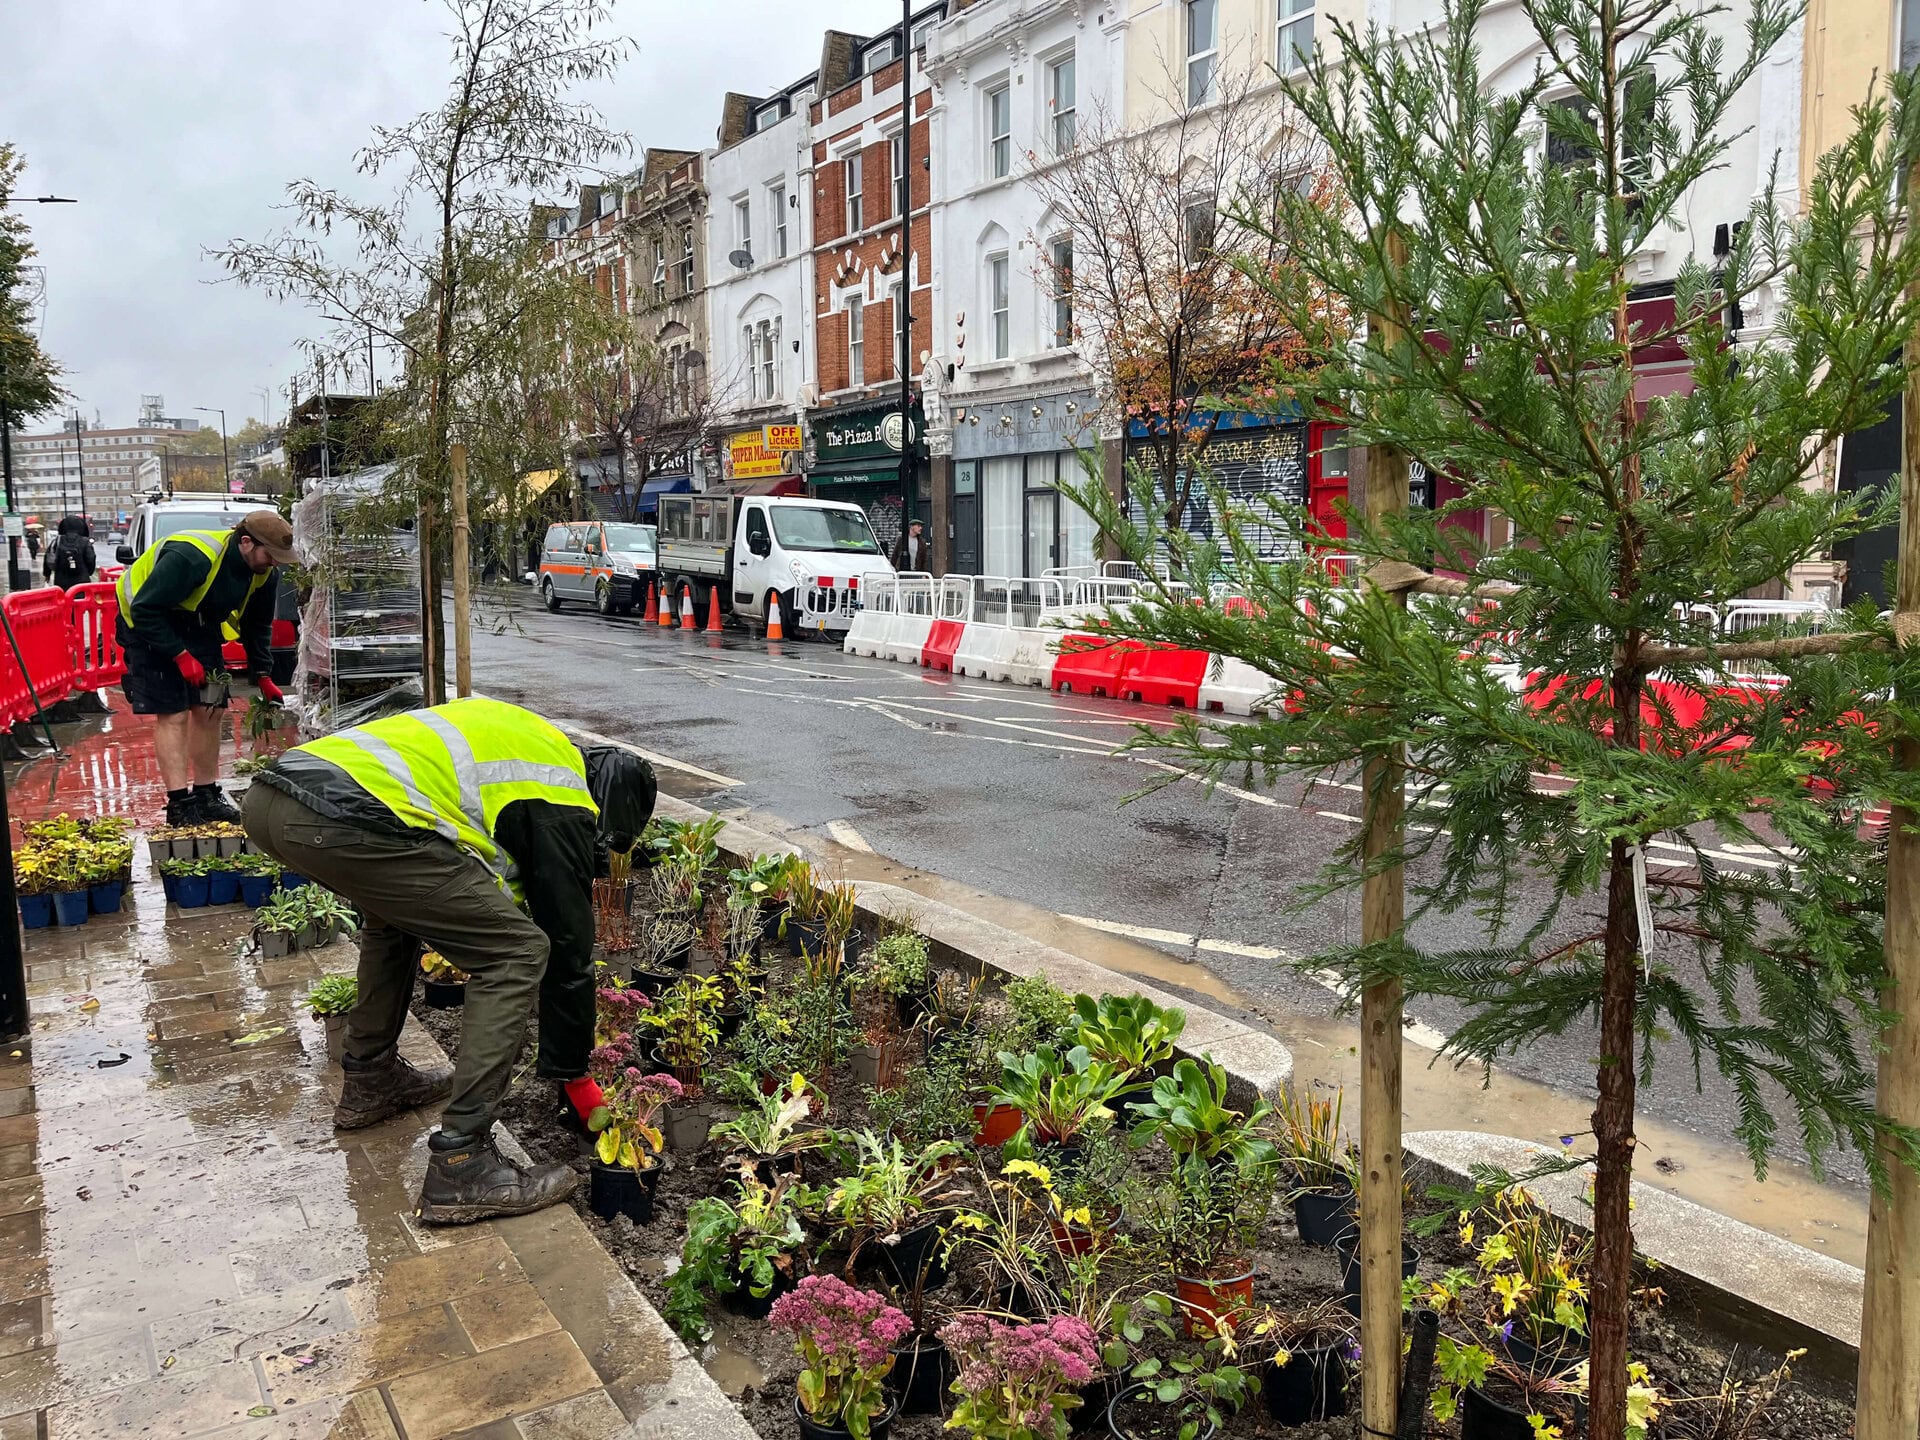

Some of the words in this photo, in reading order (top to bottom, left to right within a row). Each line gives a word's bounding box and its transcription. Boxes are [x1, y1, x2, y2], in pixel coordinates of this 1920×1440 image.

[1028, 418, 1041, 431] OF
[771, 427, 796, 437] OFF
[769, 437, 799, 445] LICENCE
[826, 431, 843, 447] The
[844, 429, 873, 445] Pizza
[732, 446, 753, 463] SUPER
[961, 471, 971, 481] 28
